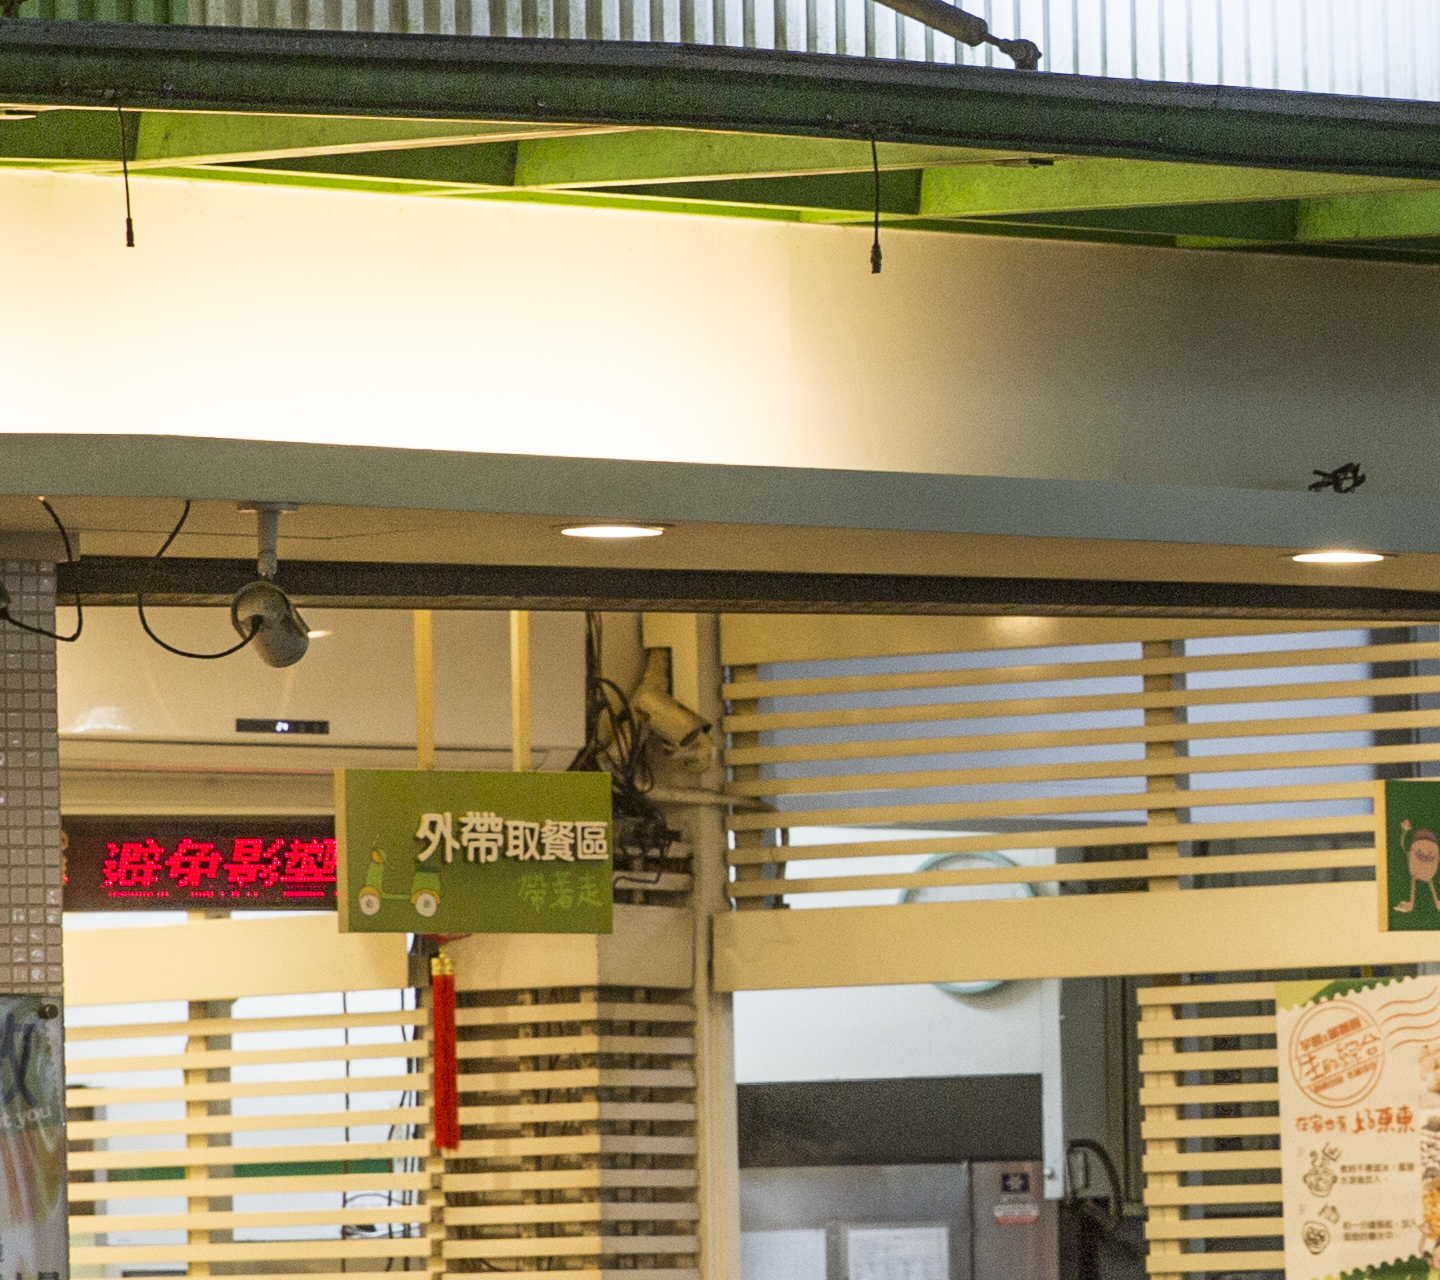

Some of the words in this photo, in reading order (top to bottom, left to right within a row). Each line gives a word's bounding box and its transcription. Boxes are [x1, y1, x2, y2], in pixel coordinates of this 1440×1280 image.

[417, 810, 609, 864] 外帶取餐區
